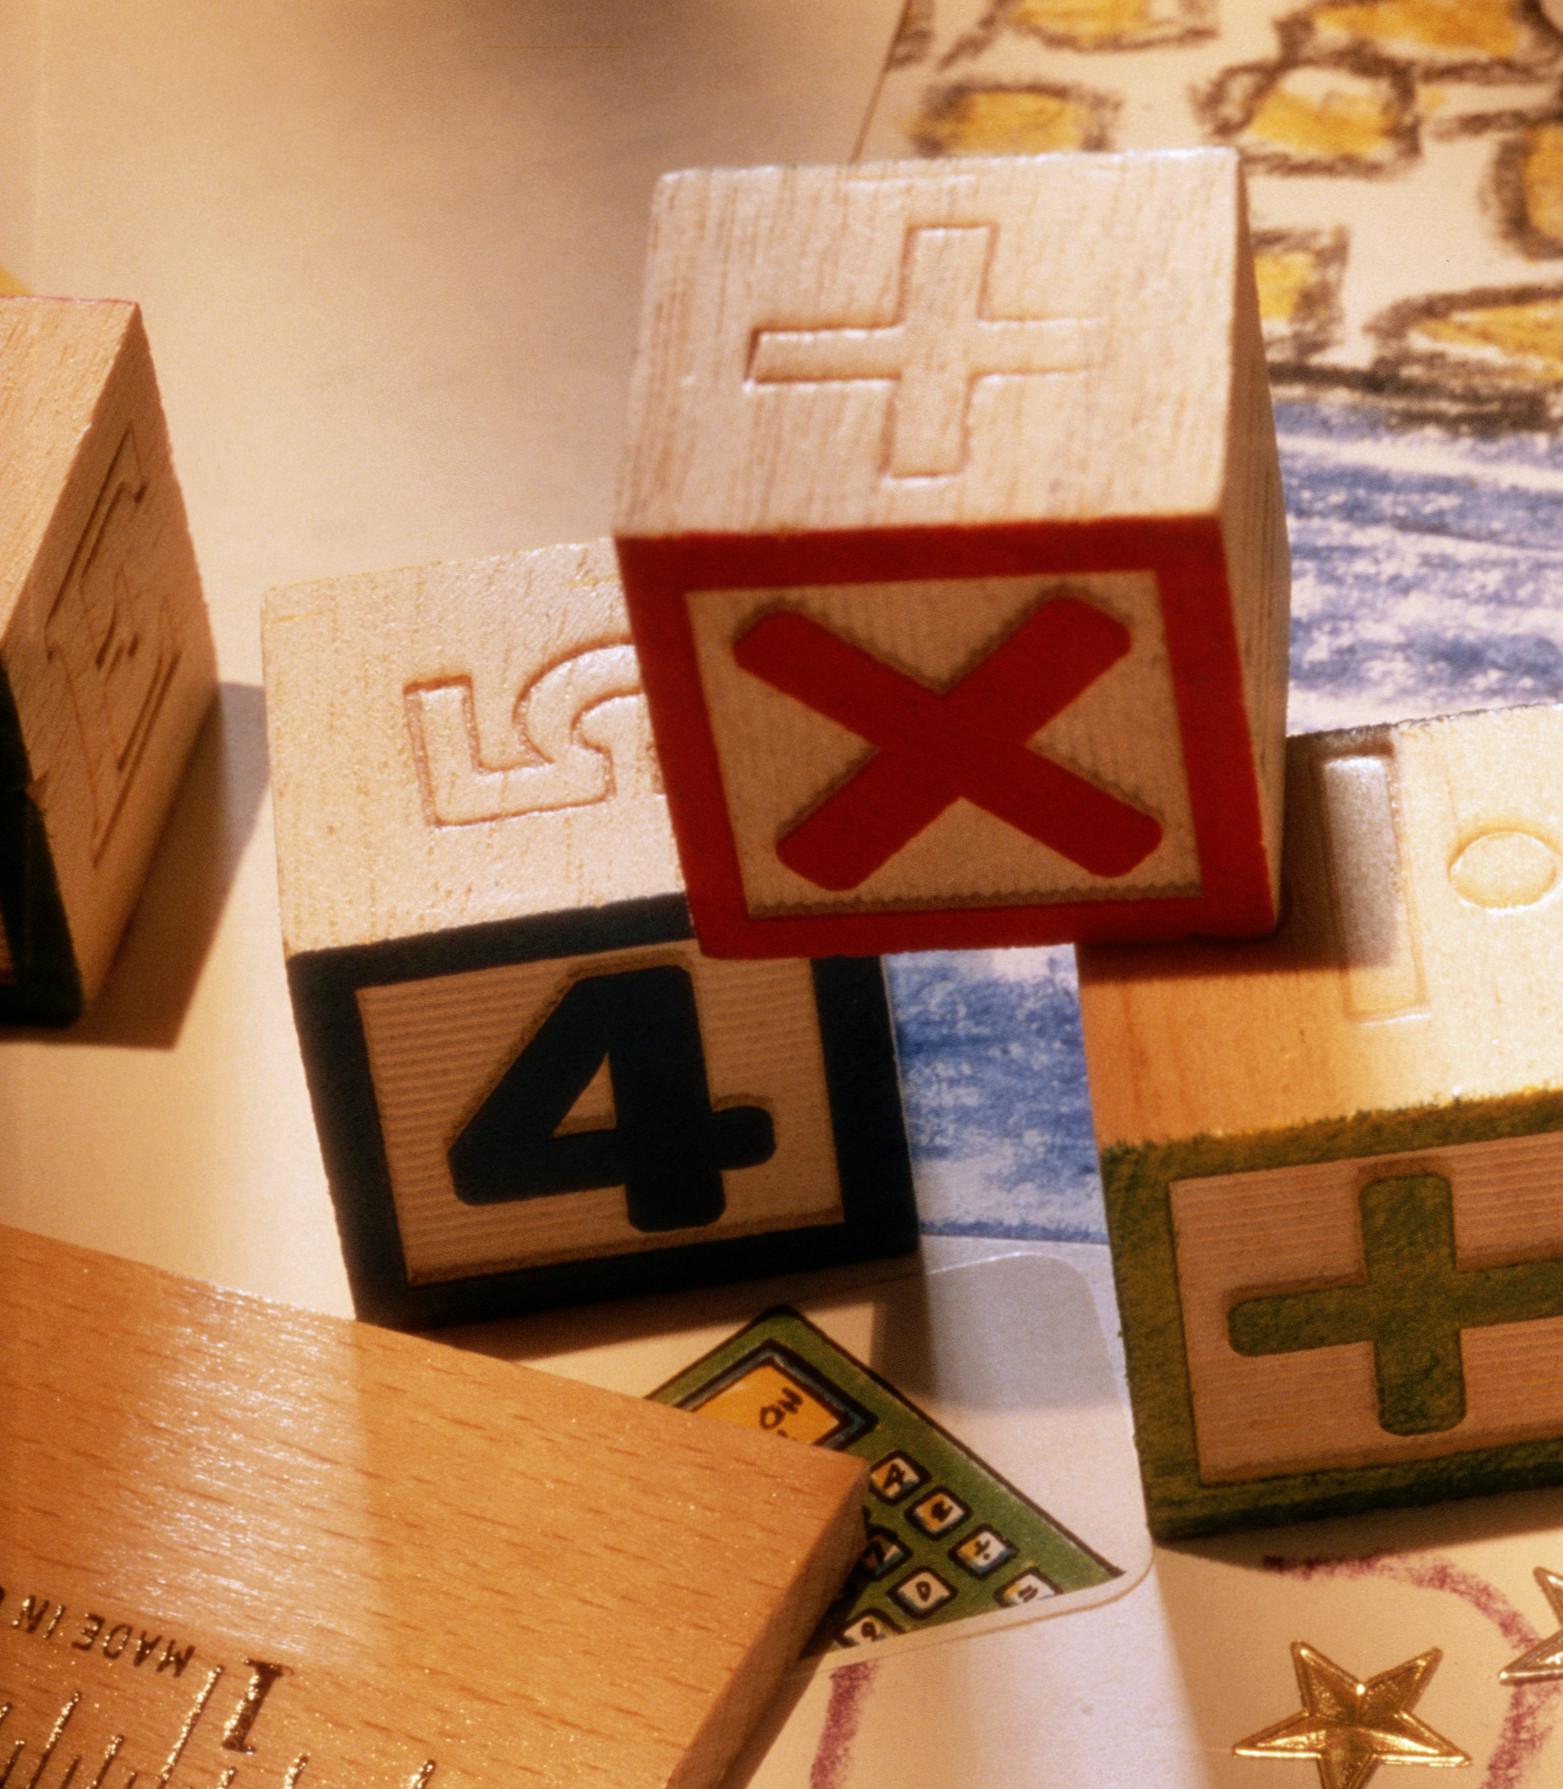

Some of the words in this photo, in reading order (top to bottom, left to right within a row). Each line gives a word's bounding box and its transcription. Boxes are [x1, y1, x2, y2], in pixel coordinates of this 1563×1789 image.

[402, 633, 668, 828] 5
[447, 965, 776, 1233] 4
[11, 1594, 66, 1640] IN
[72, 1612, 195, 1678] MADE
[222, 1657, 294, 1753] 1
